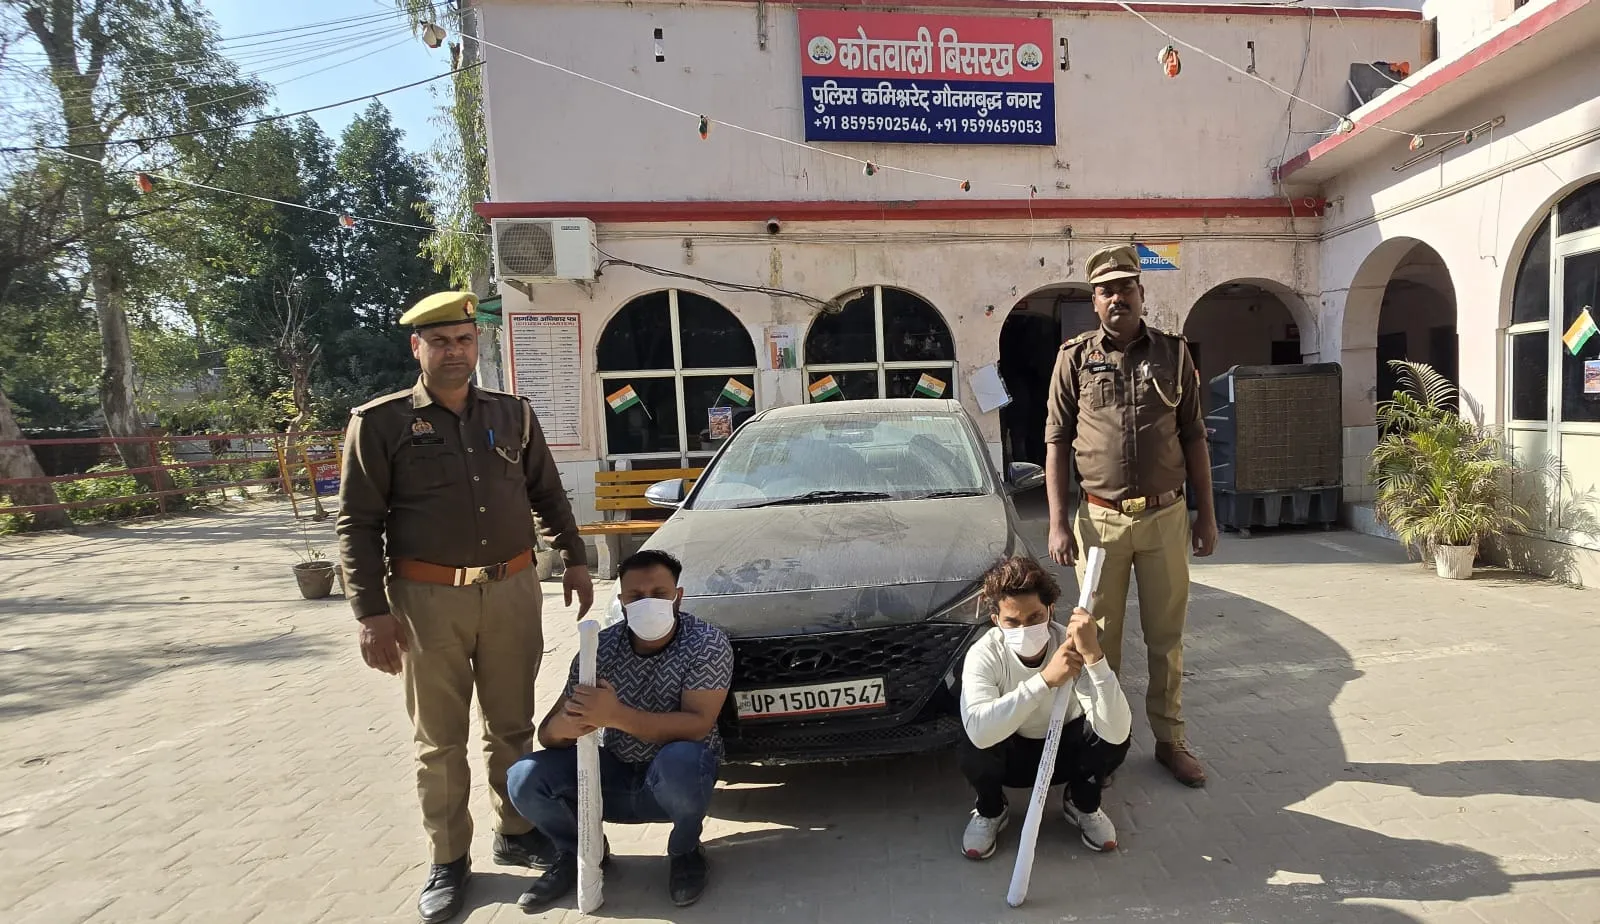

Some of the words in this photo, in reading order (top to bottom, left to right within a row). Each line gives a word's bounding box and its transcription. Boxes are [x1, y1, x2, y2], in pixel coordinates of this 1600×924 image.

[838, 25, 933, 74] कोतवाली
[938, 28, 1014, 76] बिसरख
[811, 80, 857, 113] पुलिस
[932, 83, 1002, 117] गौतमबुद्ध
[1006, 92, 1042, 110] नगर
[814, 116, 836, 130] +91
[841, 116, 931, 134] 8595902546,
[935, 118, 957, 132] +91
[962, 119, 1042, 134] 9599659053
[751, 684, 881, 713] UP15DQ7547
